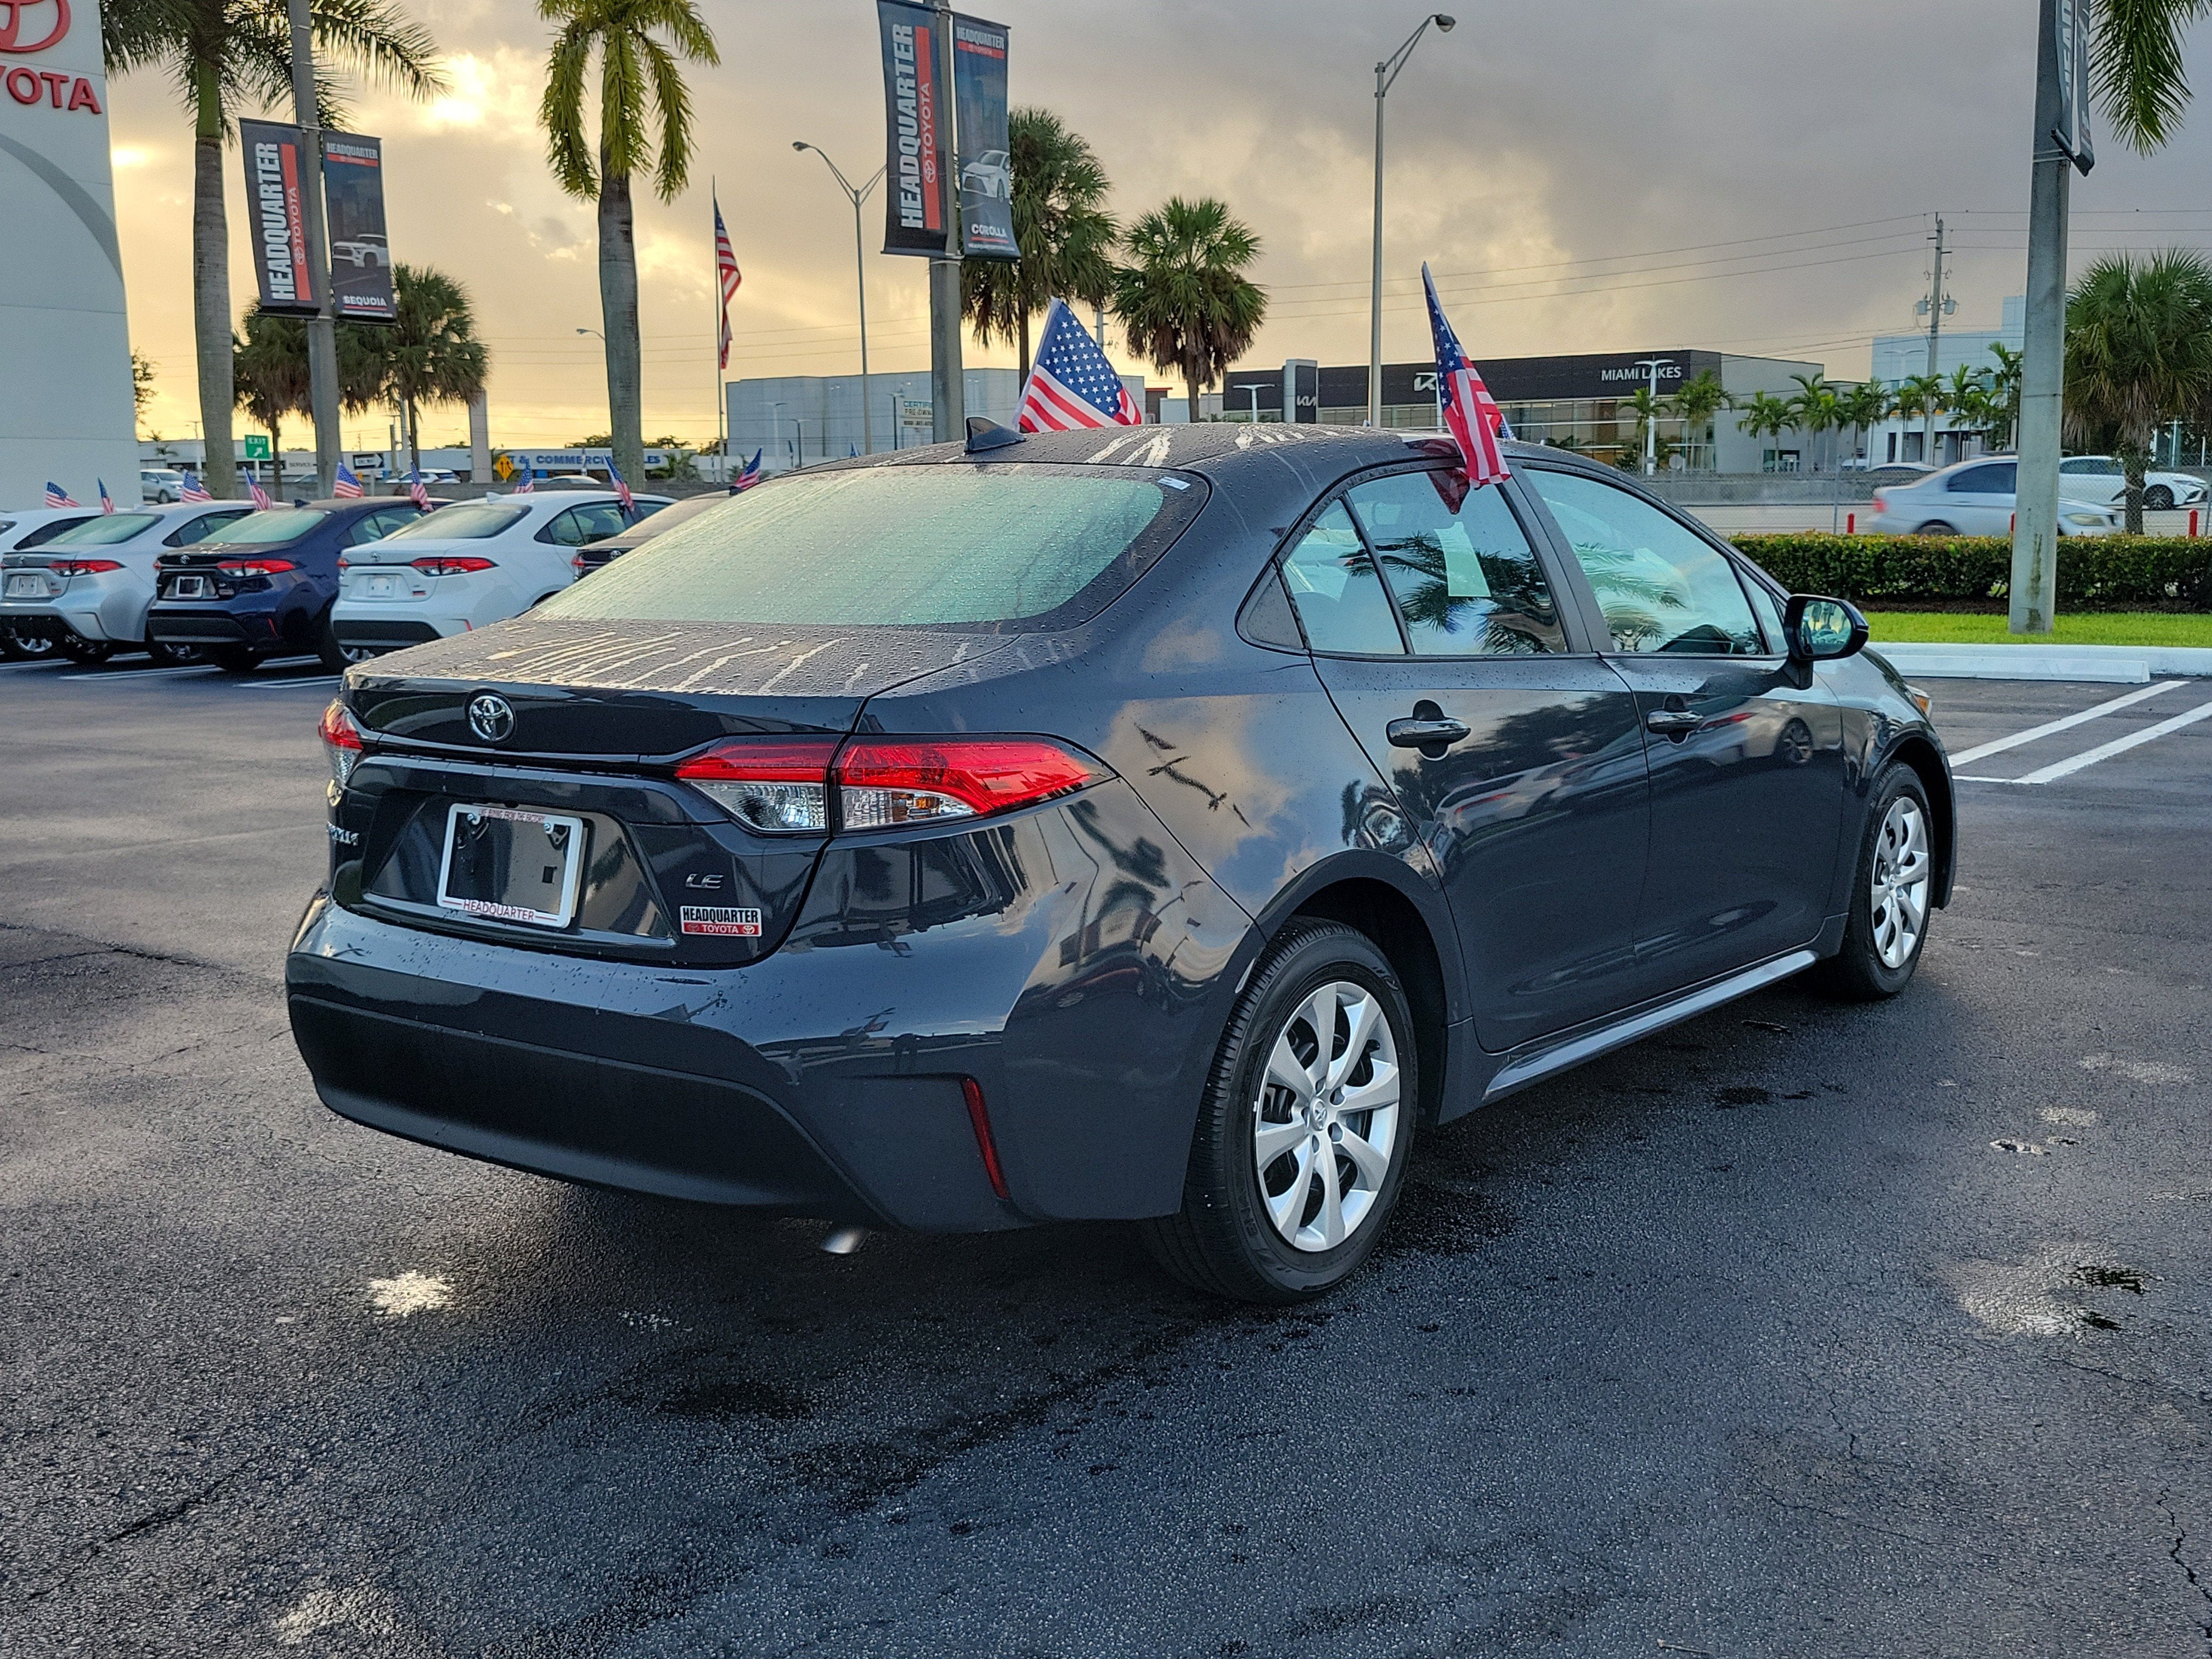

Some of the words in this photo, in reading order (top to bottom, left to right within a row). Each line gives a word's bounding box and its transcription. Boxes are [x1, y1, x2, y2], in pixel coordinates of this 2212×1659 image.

[893, 23, 923, 229] HEADQUARTER
[920, 83, 933, 157] TOYOTA
[326, 142, 378, 159] HEADQUARTER
[256, 143, 296, 301] HEADQUARTER
[287, 186, 303, 245] TOYOTA
[971, 223, 1008, 238] COROLLA
[342, 295, 387, 307] SEQUOIA
[1601, 368, 1639, 381] MIAMI
[686, 873, 724, 889] LE
[463, 899, 534, 921] HEADQUARTER
[682, 907, 758, 924] HEADQUARTER
[702, 924, 740, 934] TOYOTA
